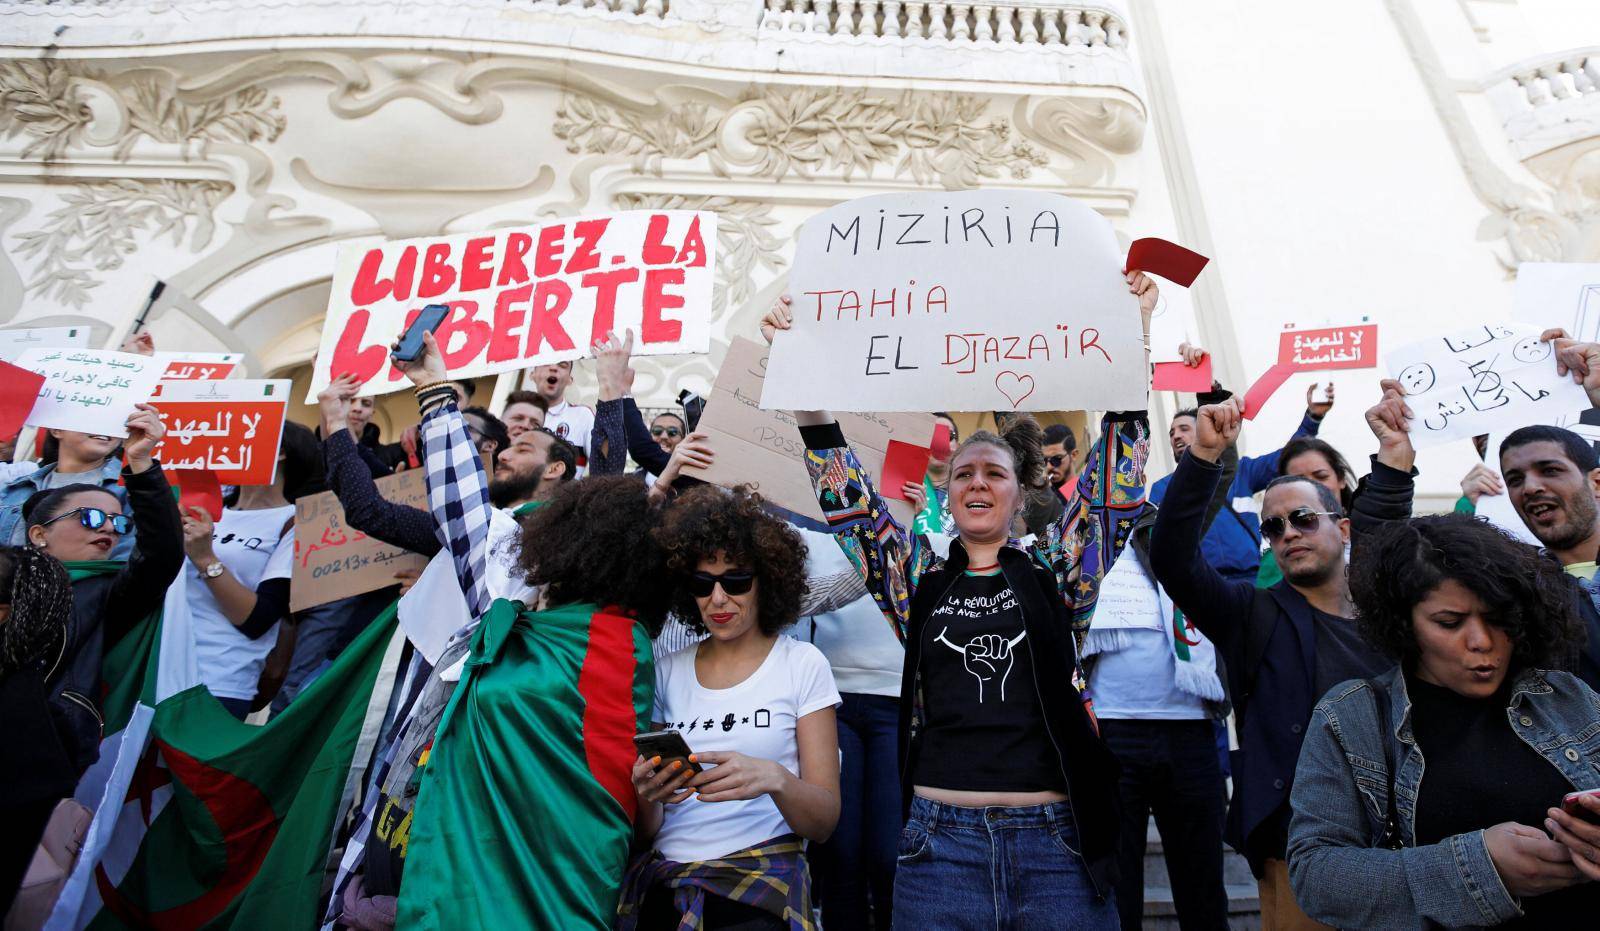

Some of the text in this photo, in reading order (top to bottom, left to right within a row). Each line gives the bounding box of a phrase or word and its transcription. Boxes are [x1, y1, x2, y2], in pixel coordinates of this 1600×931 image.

[826, 206, 1061, 255] MIZIRIA
[803, 280, 948, 322] TAHIA
[1293, 330, 1364, 351] لا للعهدة
[1443, 325, 1514, 353] قلنا
[66, 352, 102, 365] حياتك
[107, 357, 144, 373] رصيد
[865, 334, 919, 376] EL
[1292, 346, 1361, 364] الخامسة
[97, 376, 133, 389] كافي
[199, 367, 217, 380] لا
[70, 391, 113, 407] العهدة
[1512, 381, 1550, 401] ما
[242, 411, 262, 439] لا
[948, 588, 1014, 609] LA RÉVOLUTION
[932, 605, 954, 616] MAIS
[957, 608, 981, 618] AVEC
[986, 607, 998, 615] LE
